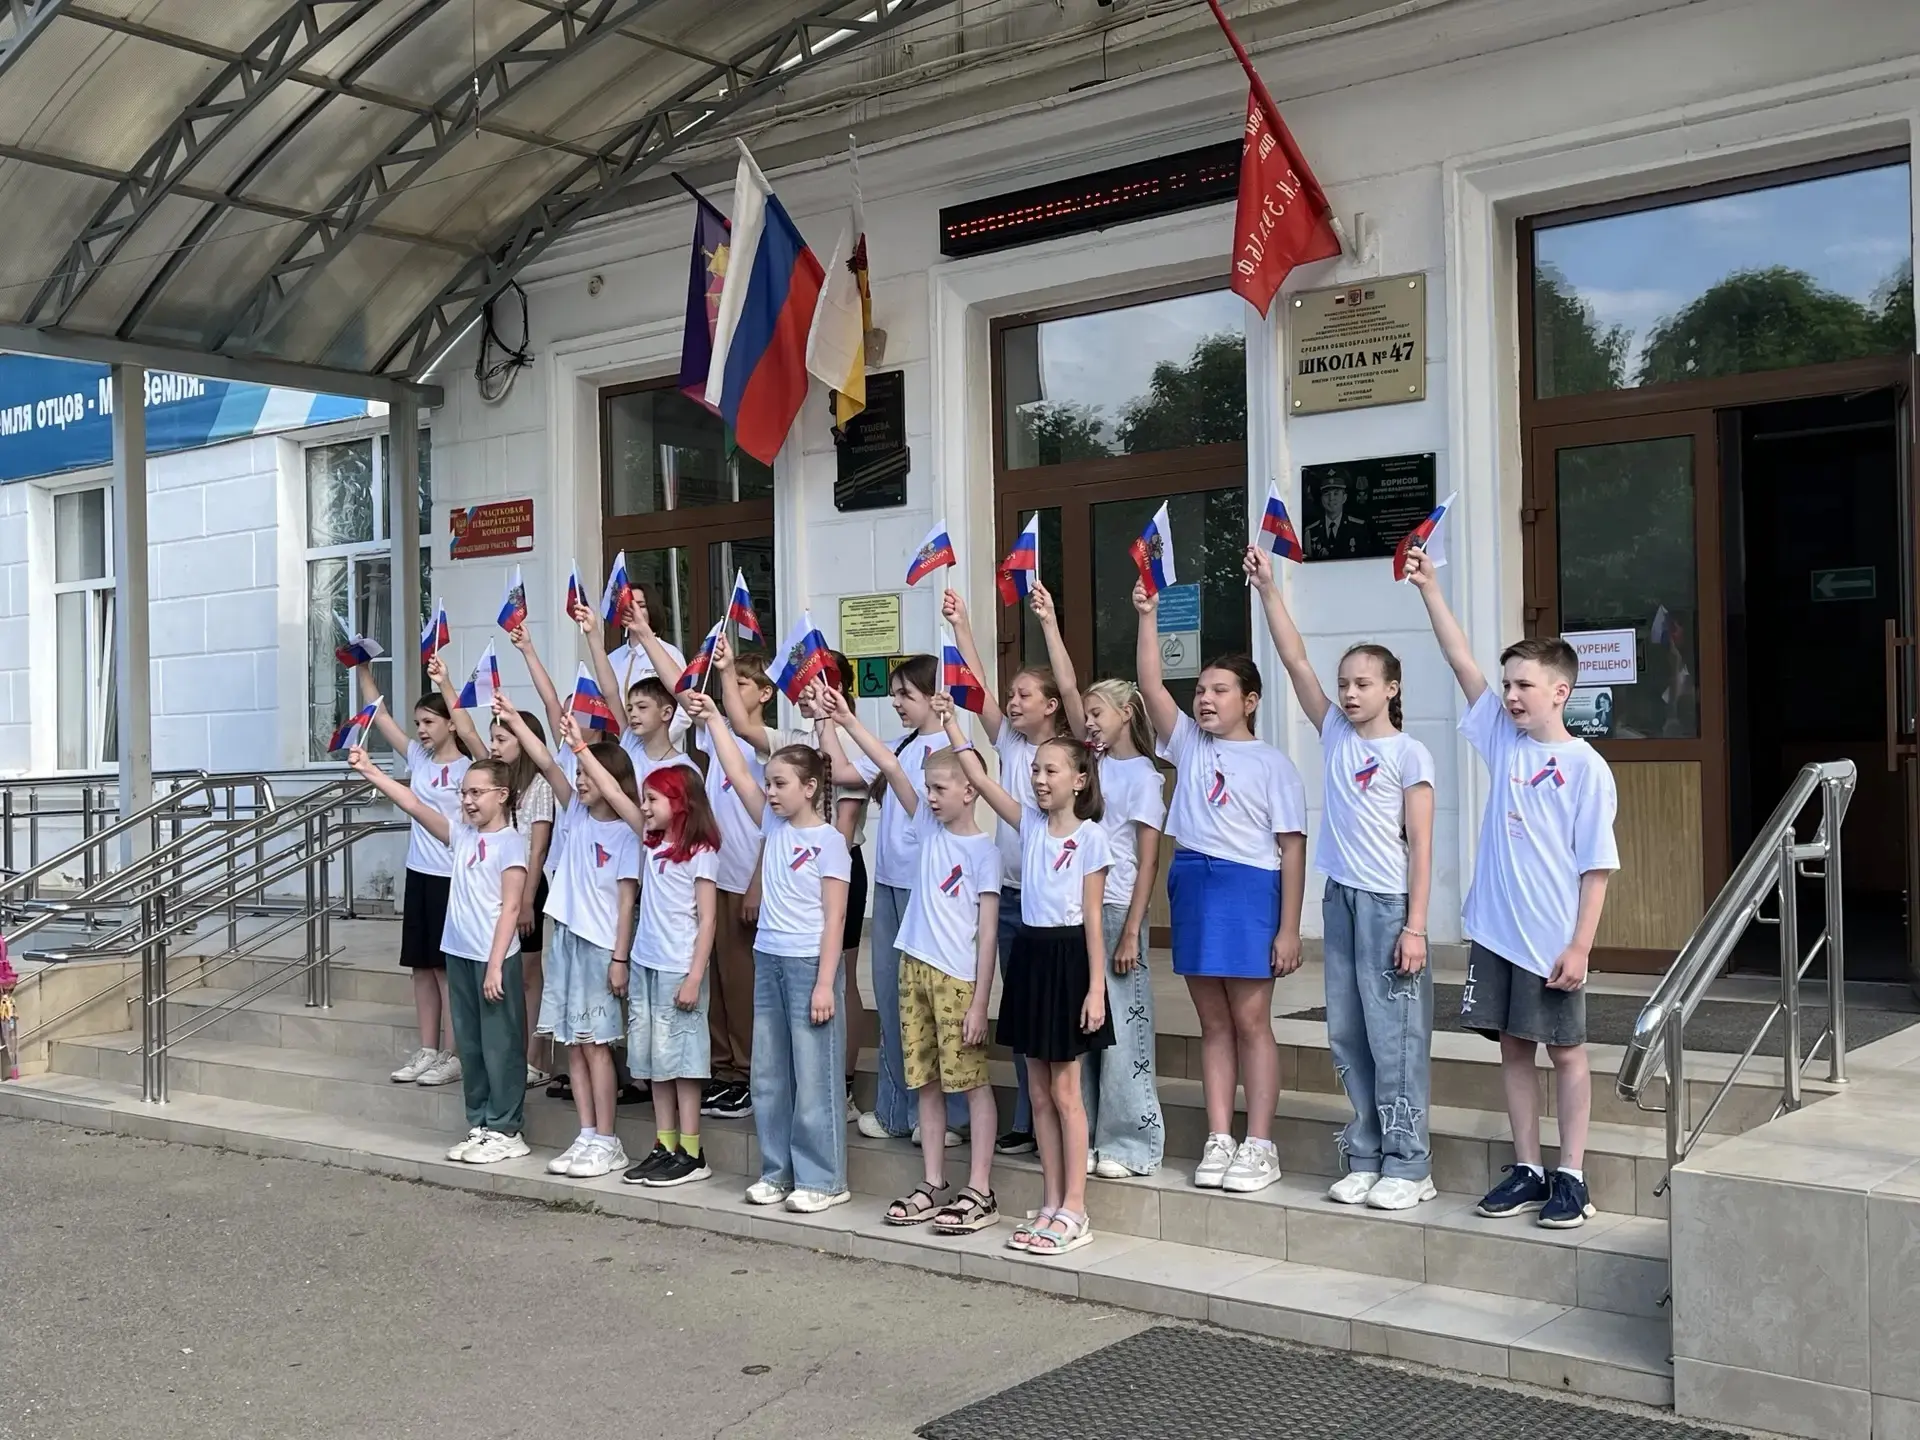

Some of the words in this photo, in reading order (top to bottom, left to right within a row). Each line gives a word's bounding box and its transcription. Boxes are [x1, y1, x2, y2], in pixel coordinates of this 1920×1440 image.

[1301, 344, 1329, 353] СРЕДНЯЯ
[1330, 332, 1411, 349] ОБЩЕОБРАЗОВАТЕЛЬНАЯ
[1298, 351, 1367, 375] ШКОЛА
[1372, 350, 1387, 365] №
[1389, 341, 1414, 362] 47
[1347, 370, 1379, 380] СОВЕТСКОГО
[0, 404, 32, 436] мля
[1381, 476, 1419, 487] БОРИСОВ
[478, 505, 524, 517] УЧАСТКОВАЯ
[472, 514, 531, 529] ИЗБИРАТЕЛЬНАЯ
[481, 525, 521, 537] КОМИССИЯ
[1576, 642, 1621, 654] КУРЕНИЕ
[1578, 658, 1632, 672] ПРЕЩЕНО!
